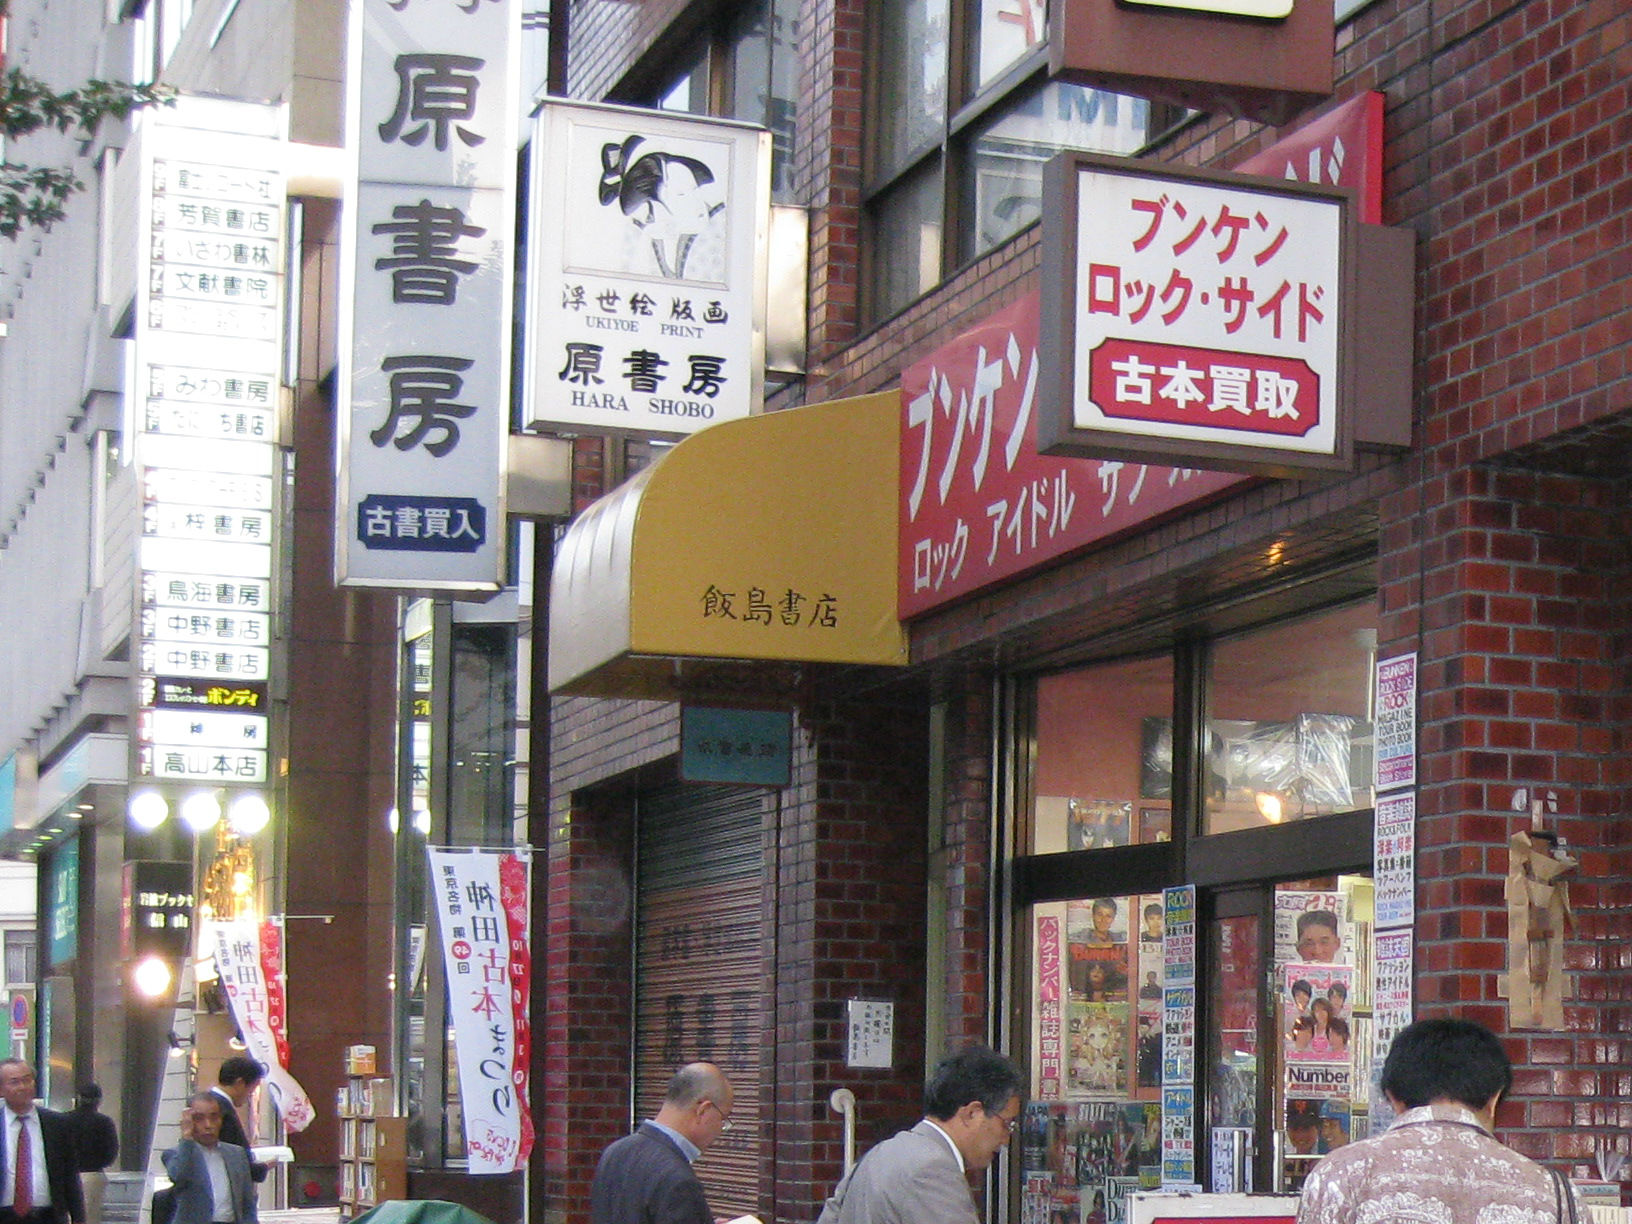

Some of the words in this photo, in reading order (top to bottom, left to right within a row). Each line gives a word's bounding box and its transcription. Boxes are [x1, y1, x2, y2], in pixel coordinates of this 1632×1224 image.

[178, 203, 270, 232] 芳賀書店
[1131, 193, 1289, 267] ブンケン
[370, 53, 487, 458] 原書房
[176, 272, 269, 299] 文献書院
[1088, 263, 1325, 343] ロック・サイド
[586, 315, 639, 333] UKIYOE
[660, 323, 704, 339] PRINT
[558, 341, 729, 399] 原書房
[571, 390, 630, 412] HARA
[648, 397, 715, 420] SHOBO
[1111, 355, 1301, 421] 古本買取
[909, 332, 1040, 523] ブンケン
[366, 505, 481, 540] 古書買入
[986, 469, 1076, 566] アイドル
[914, 518, 969, 593] ロック
[168, 580, 261, 606] 鳥海書房
[700, 584, 838, 629] 飯島書店
[168, 615, 260, 639] 中野書店
[167, 651, 259, 674] 中野書店
[207, 687, 259, 707] ボンディ
[165, 752, 257, 777] 高山本店
[1040, 917, 1059, 1100] バックナンバー雑誌専門書
[1288, 1066, 1350, 1084] Number
